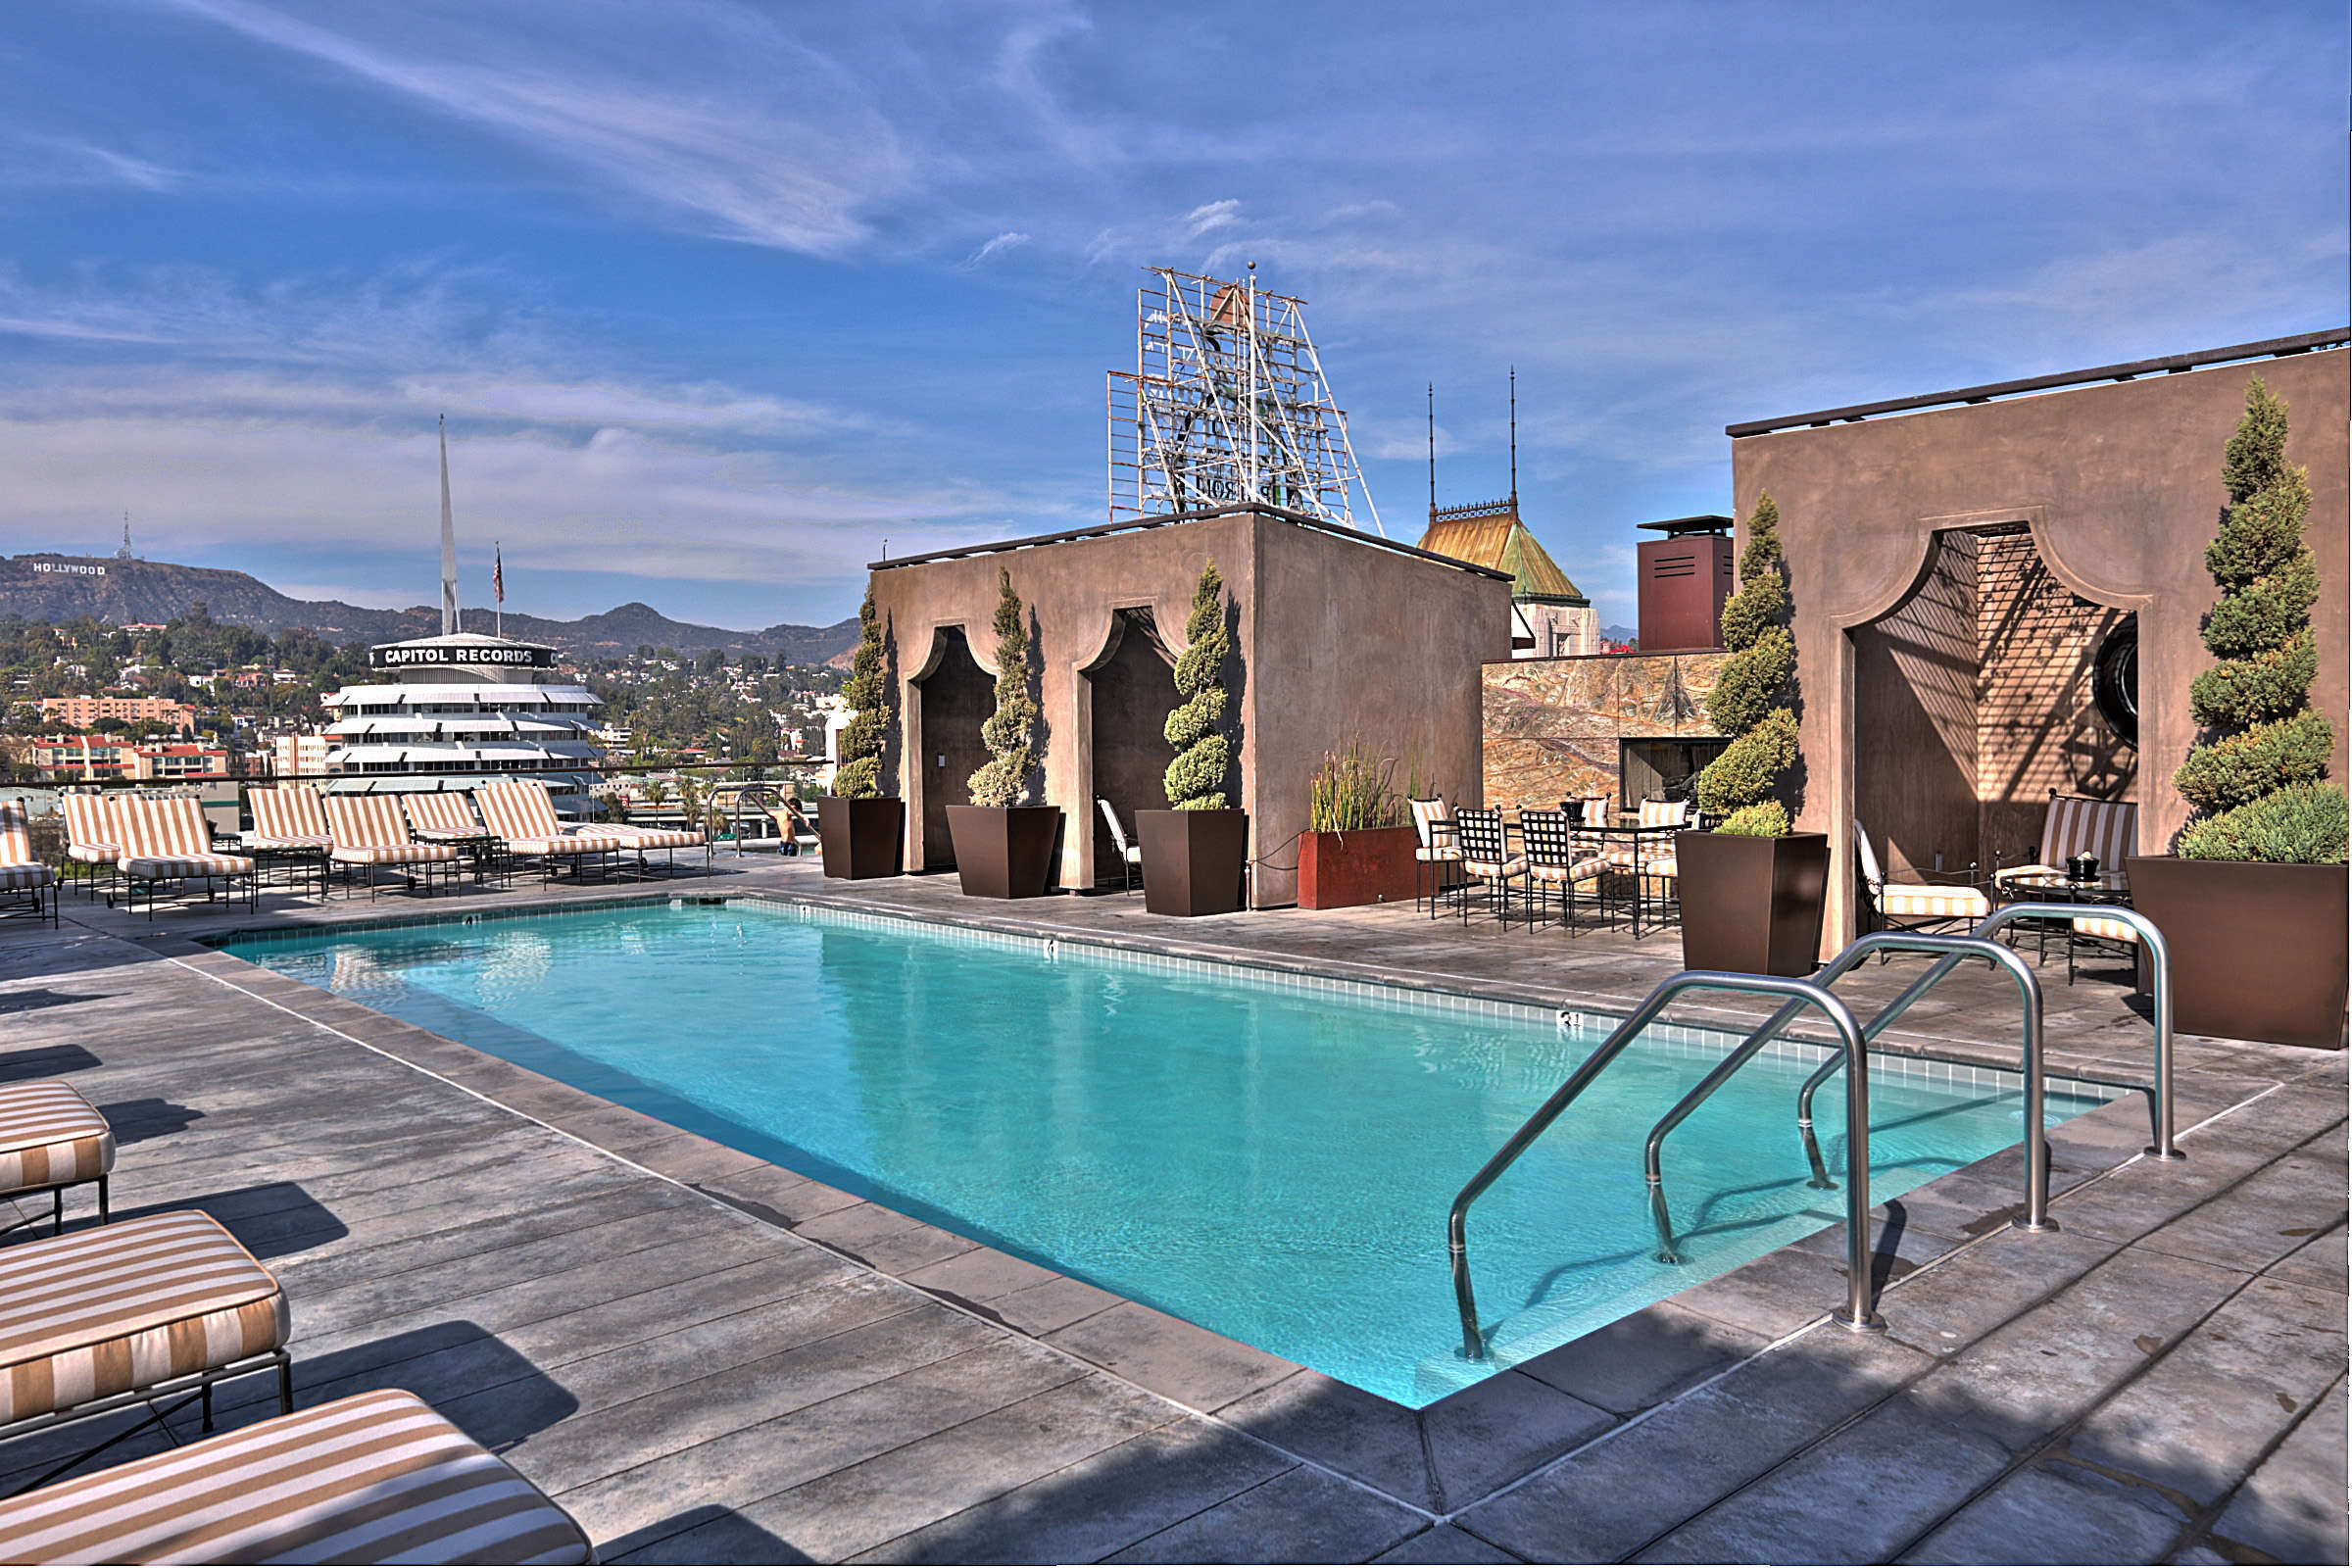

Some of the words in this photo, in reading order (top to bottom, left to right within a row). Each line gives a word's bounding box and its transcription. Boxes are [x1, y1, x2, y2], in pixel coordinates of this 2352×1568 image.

[33, 563, 106, 575] HOLLYWOOD
[385, 649, 449, 663] CAPITOL
[456, 649, 533, 663] RECORDS
